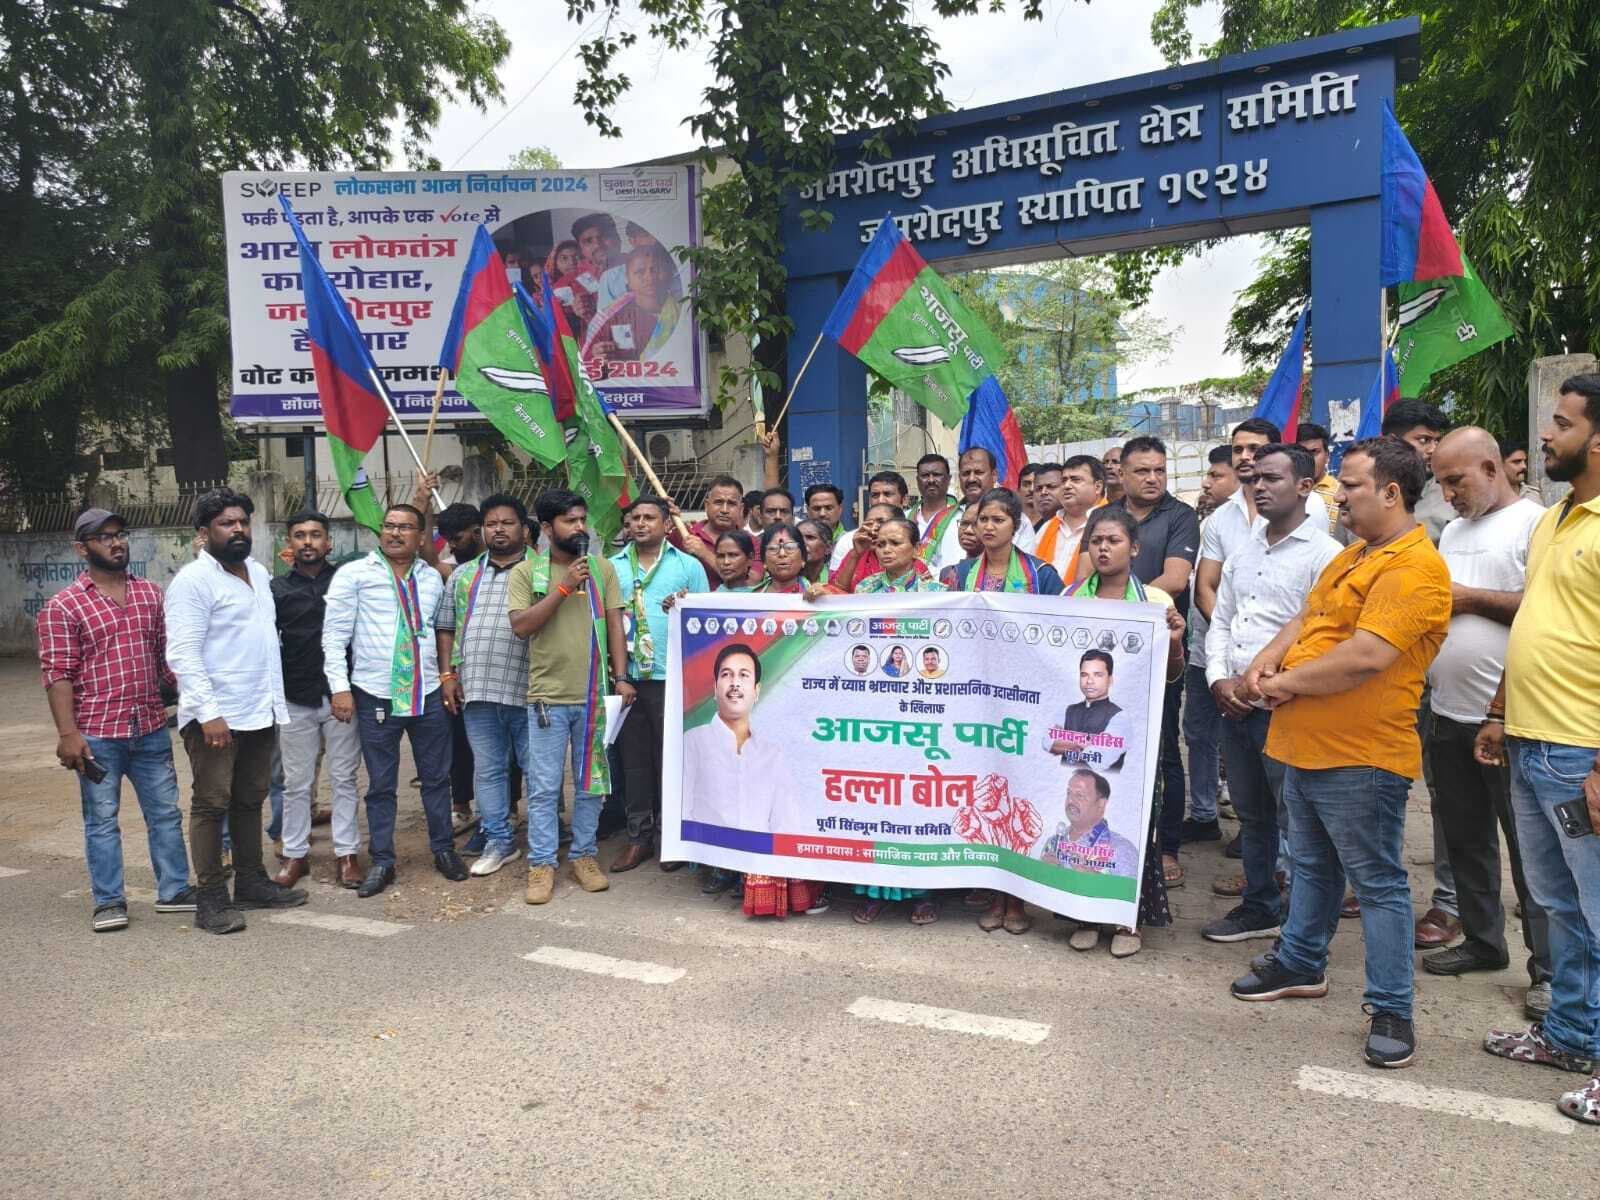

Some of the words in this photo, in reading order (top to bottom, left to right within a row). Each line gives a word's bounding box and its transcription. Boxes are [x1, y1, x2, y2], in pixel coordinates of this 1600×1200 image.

[952, 120, 1120, 176] अधिसूचित
[1139, 104, 1204, 145] क्षेत्र
[1227, 71, 1360, 130] समिति
[334, 175, 417, 196] लोकसभा
[421, 178, 462, 195] आम
[466, 173, 537, 194] निर्वाचन
[541, 176, 589, 193] 2024
[1017, 177, 1145, 226] स्थापित
[1159, 158, 1269, 205] १९२४
[242, 208, 277, 226] फर्क
[348, 206, 399, 224] आपके
[403, 209, 434, 224] एक
[484, 204, 501, 223] से
[329, 234, 458, 259] लोकतंत्र
[240, 364, 283, 385] वोट
[607, 360, 679, 379] 2024
[801, 677, 826, 690] राज्य
[828, 675, 841, 691] में
[911, 678, 932, 695] और
[934, 680, 991, 697] प्रशासनिक
[992, 684, 1041, 705] उदासीनता
[899, 699, 909, 713] के
[910, 700, 946, 714] खिलाफ
[812, 715, 951, 761] आजसू
[953, 717, 1029, 756] पार्टी
[822, 768, 905, 807] हल्ला
[909, 764, 978, 808] बोल
[816, 816, 836, 833] पूर्वी
[839, 817, 878, 835] सिंहभूम
[881, 820, 912, 836] जिला
[915, 822, 952, 836] समिति
[796, 842, 824, 856] हमारा
[826, 843, 853, 858] प्रयास
[912, 851, 938, 862] न्याय
[941, 847, 961, 862] और
[963, 848, 999, 863] विकास
